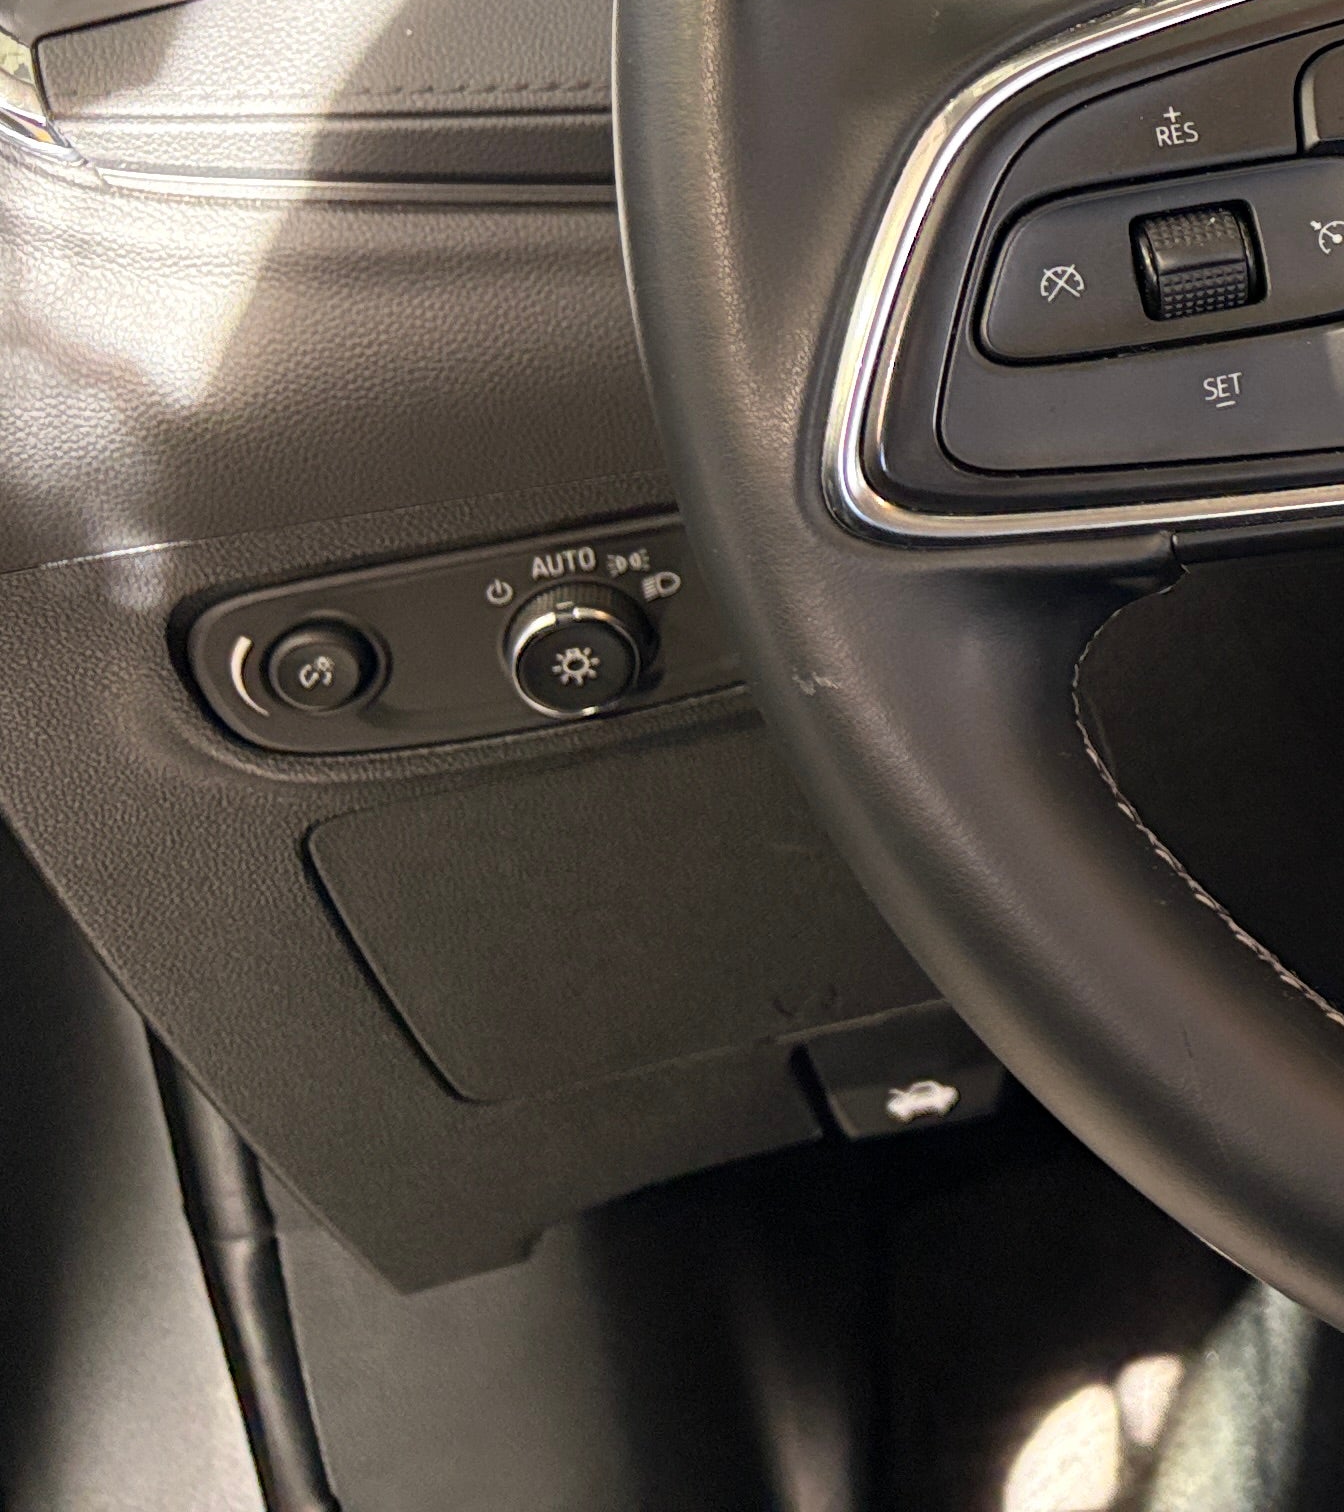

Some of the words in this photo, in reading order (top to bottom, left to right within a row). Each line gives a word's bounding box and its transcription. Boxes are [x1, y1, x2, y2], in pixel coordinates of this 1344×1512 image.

[1156, 121, 1199, 147] RES
[1203, 372, 1243, 401] SET
[531, 546, 597, 580] AUTO
